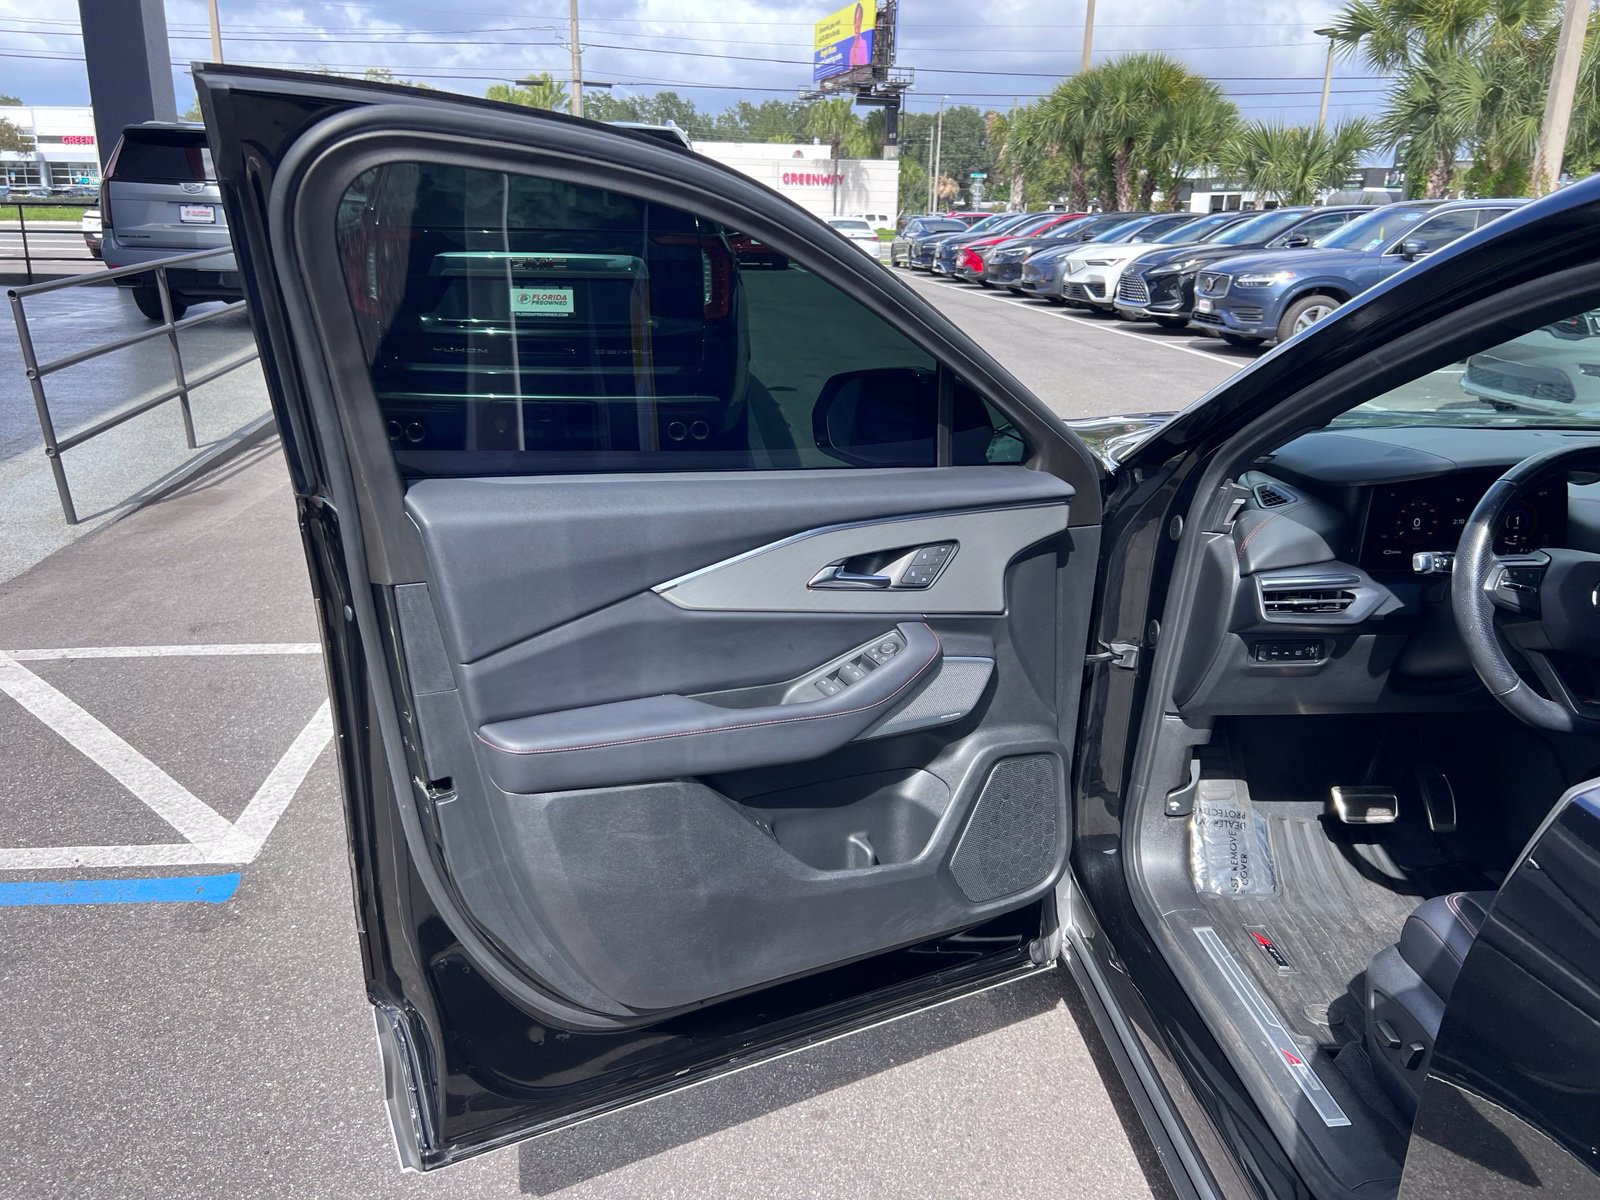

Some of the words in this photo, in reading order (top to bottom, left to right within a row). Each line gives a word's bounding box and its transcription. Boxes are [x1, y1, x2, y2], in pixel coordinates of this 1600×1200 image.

[1413, 517, 1421, 527] 0
[1213, 820, 1247, 830] DEALER
[1240, 853, 1248, 886] COVER
